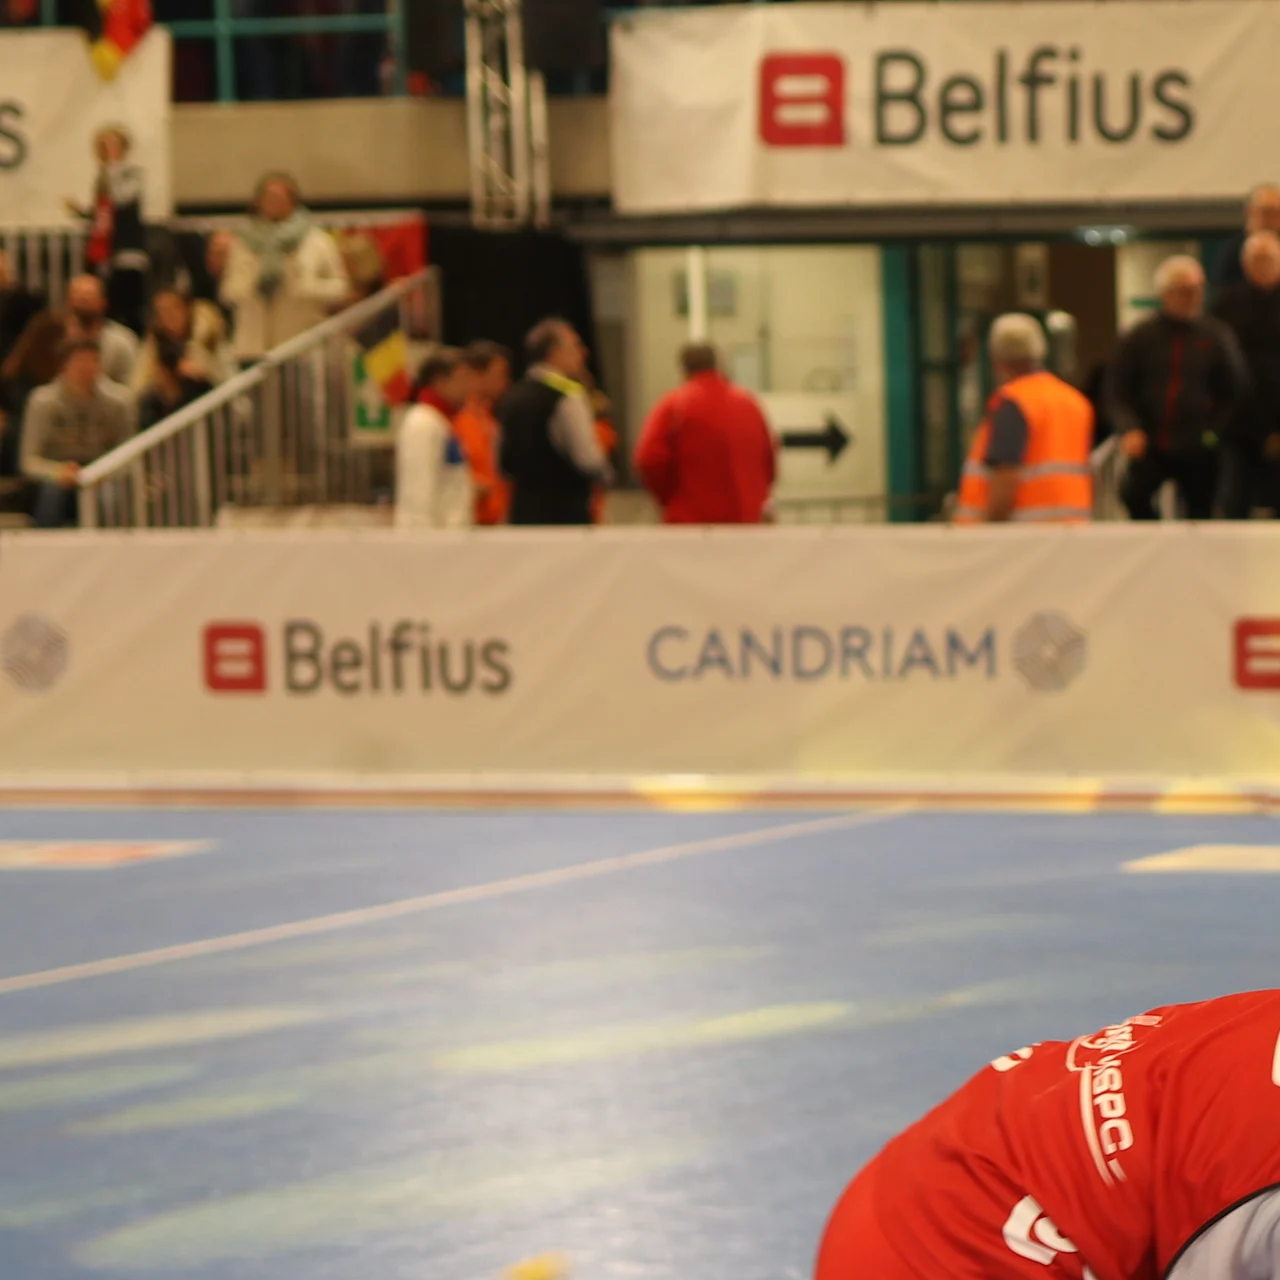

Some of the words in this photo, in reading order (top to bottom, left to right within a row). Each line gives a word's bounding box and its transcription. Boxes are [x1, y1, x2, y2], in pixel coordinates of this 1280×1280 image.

[874, 45, 1195, 147] Belfius
[283, 618, 514, 697] Belfius
[645, 624, 999, 682] CANDRIAM
